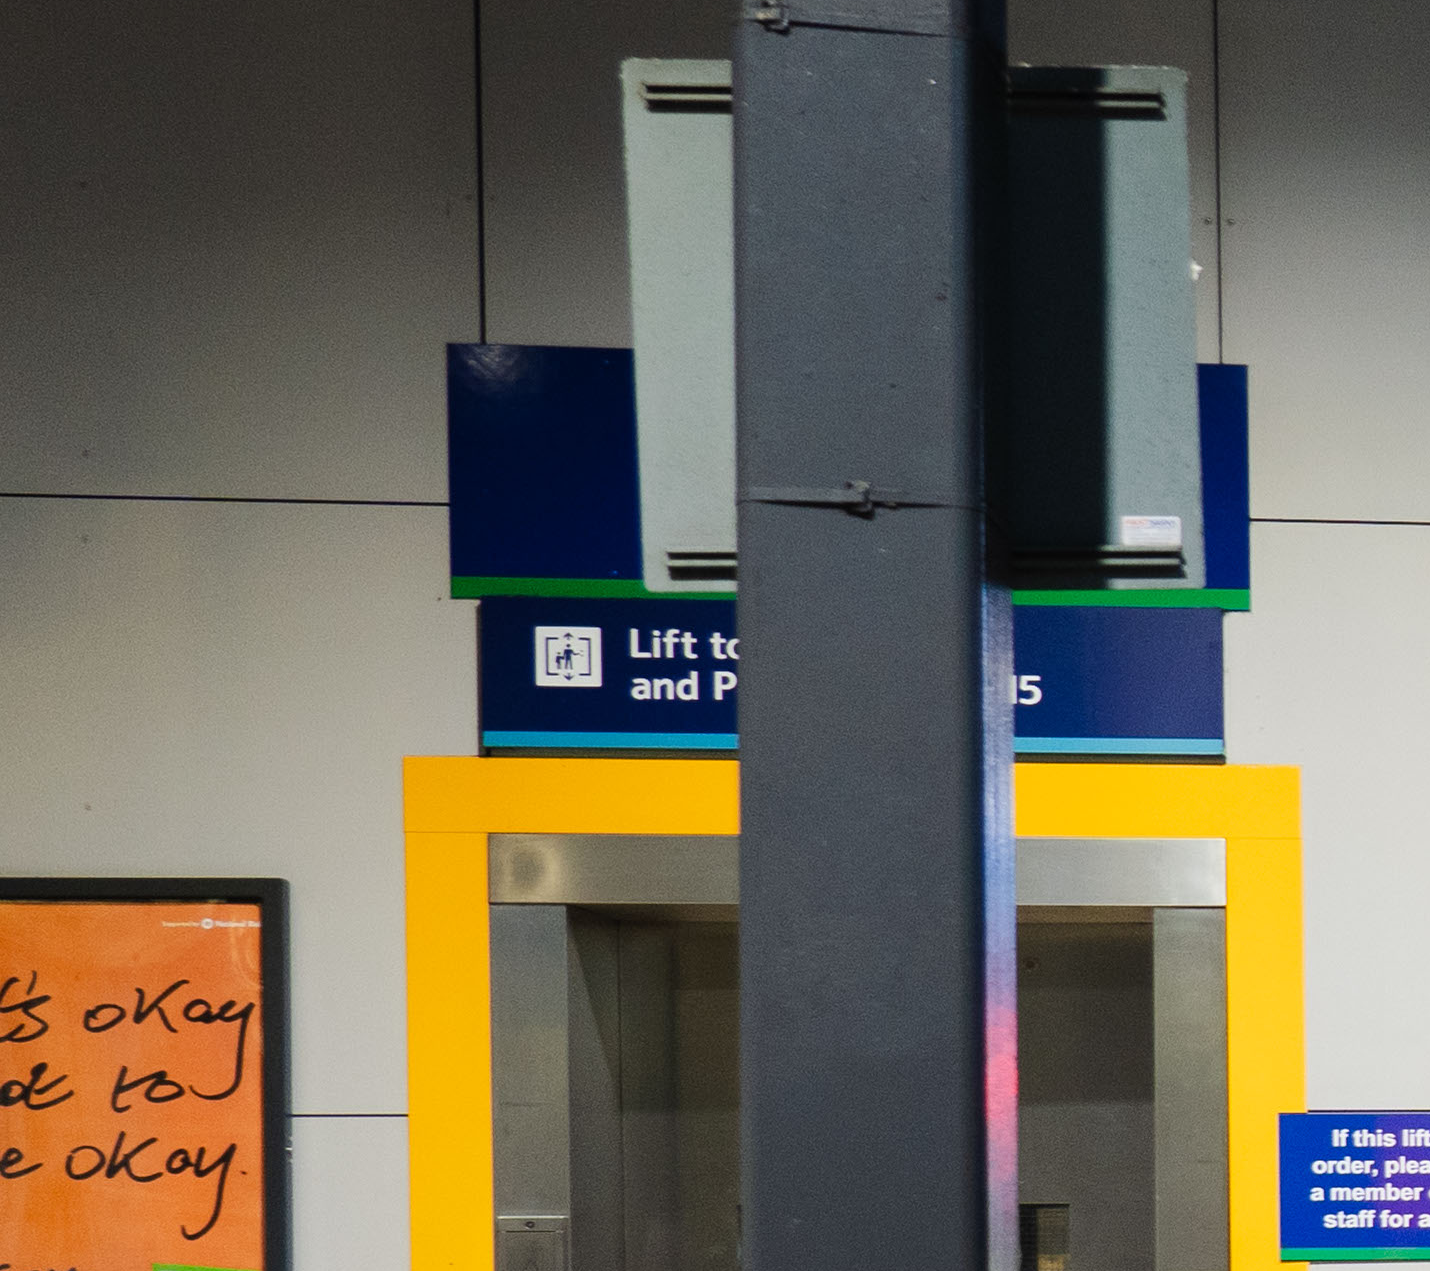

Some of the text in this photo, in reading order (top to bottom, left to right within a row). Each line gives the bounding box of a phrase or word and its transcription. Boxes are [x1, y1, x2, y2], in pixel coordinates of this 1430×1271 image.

[629, 629, 698, 660] Lift
[631, 671, 699, 701] and
[0, 1062, 185, 1113] ot to
[1332, 1129, 1349, 1147] If
[1353, 1129, 1397, 1147] this
[1311, 1156, 1379, 1178] order,
[1310, 1187, 1325, 1201] a
[1330, 1183, 1424, 1201] member
[1323, 1209, 1376, 1229] staff
[1379, 1209, 1413, 1228] for
